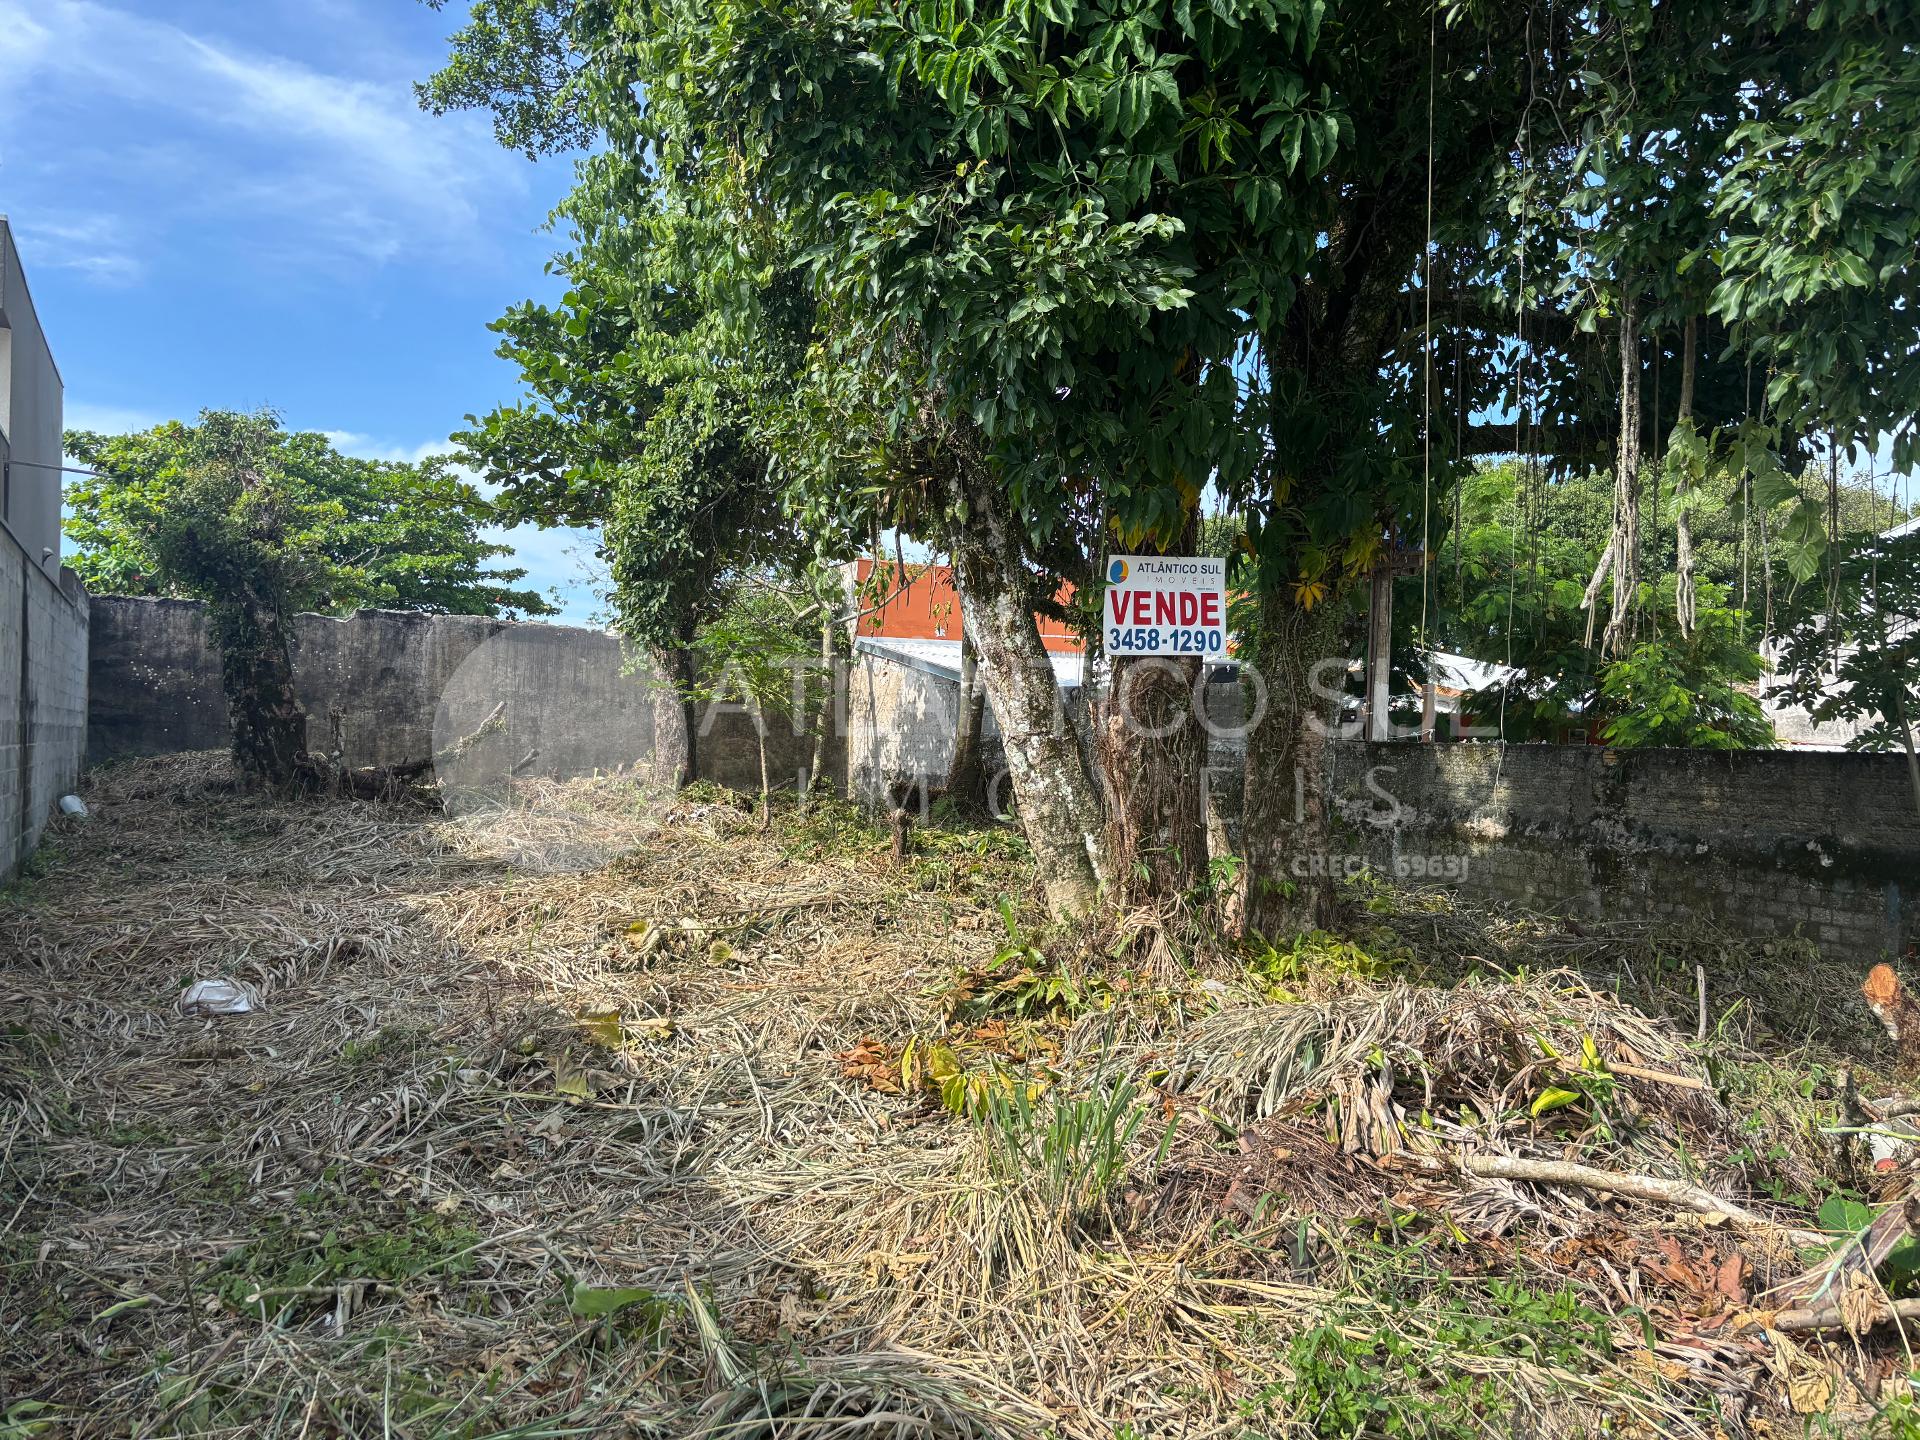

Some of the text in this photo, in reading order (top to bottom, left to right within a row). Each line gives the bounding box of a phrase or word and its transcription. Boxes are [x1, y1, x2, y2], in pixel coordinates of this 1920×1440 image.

[1137, 562, 1222, 575] ATLÂNTICO SUL
[1110, 589, 1221, 627] VENDE
[1108, 628, 1222, 652] 3458-1290
